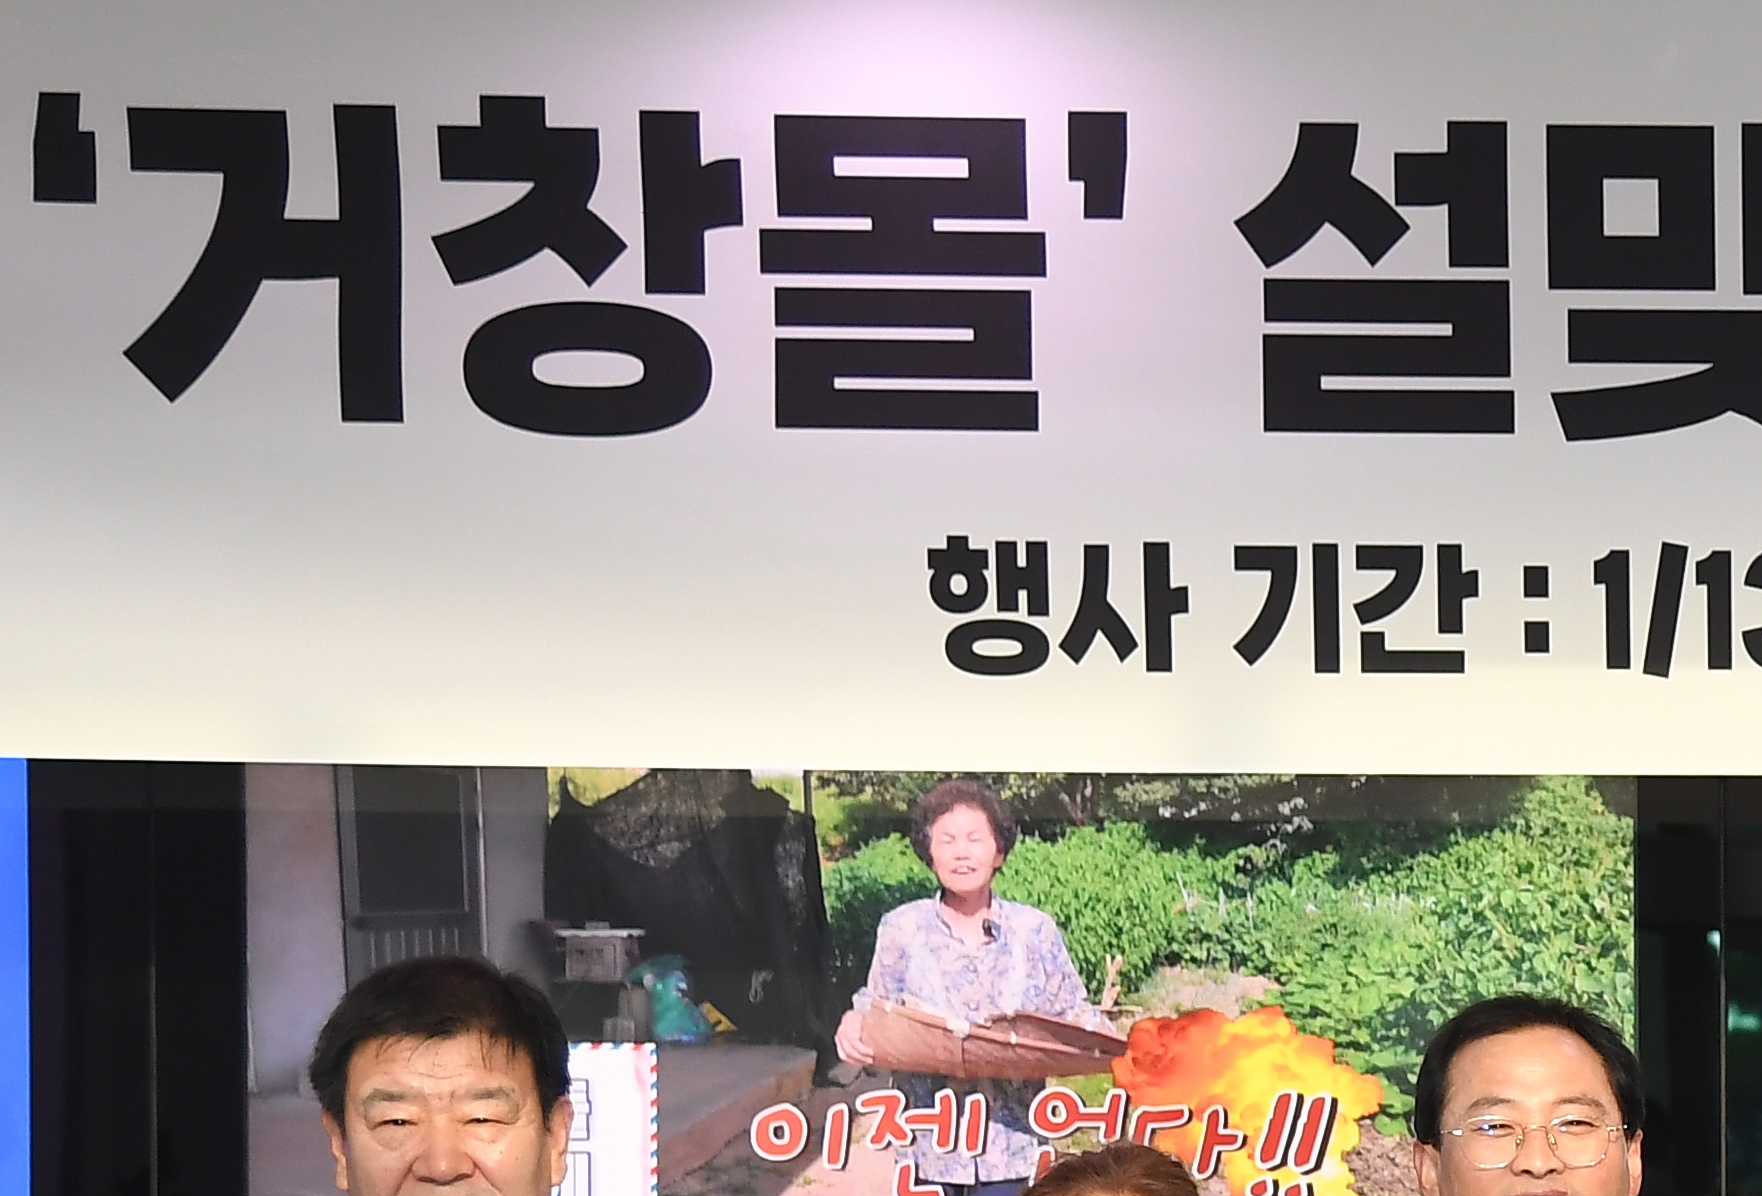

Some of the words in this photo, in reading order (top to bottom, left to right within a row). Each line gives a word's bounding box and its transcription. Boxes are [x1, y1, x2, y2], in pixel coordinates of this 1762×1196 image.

[928, 536, 1188, 675] 행사
[1234, 544, 1478, 673] 기간
[1524, 566, 1549, 652] :
